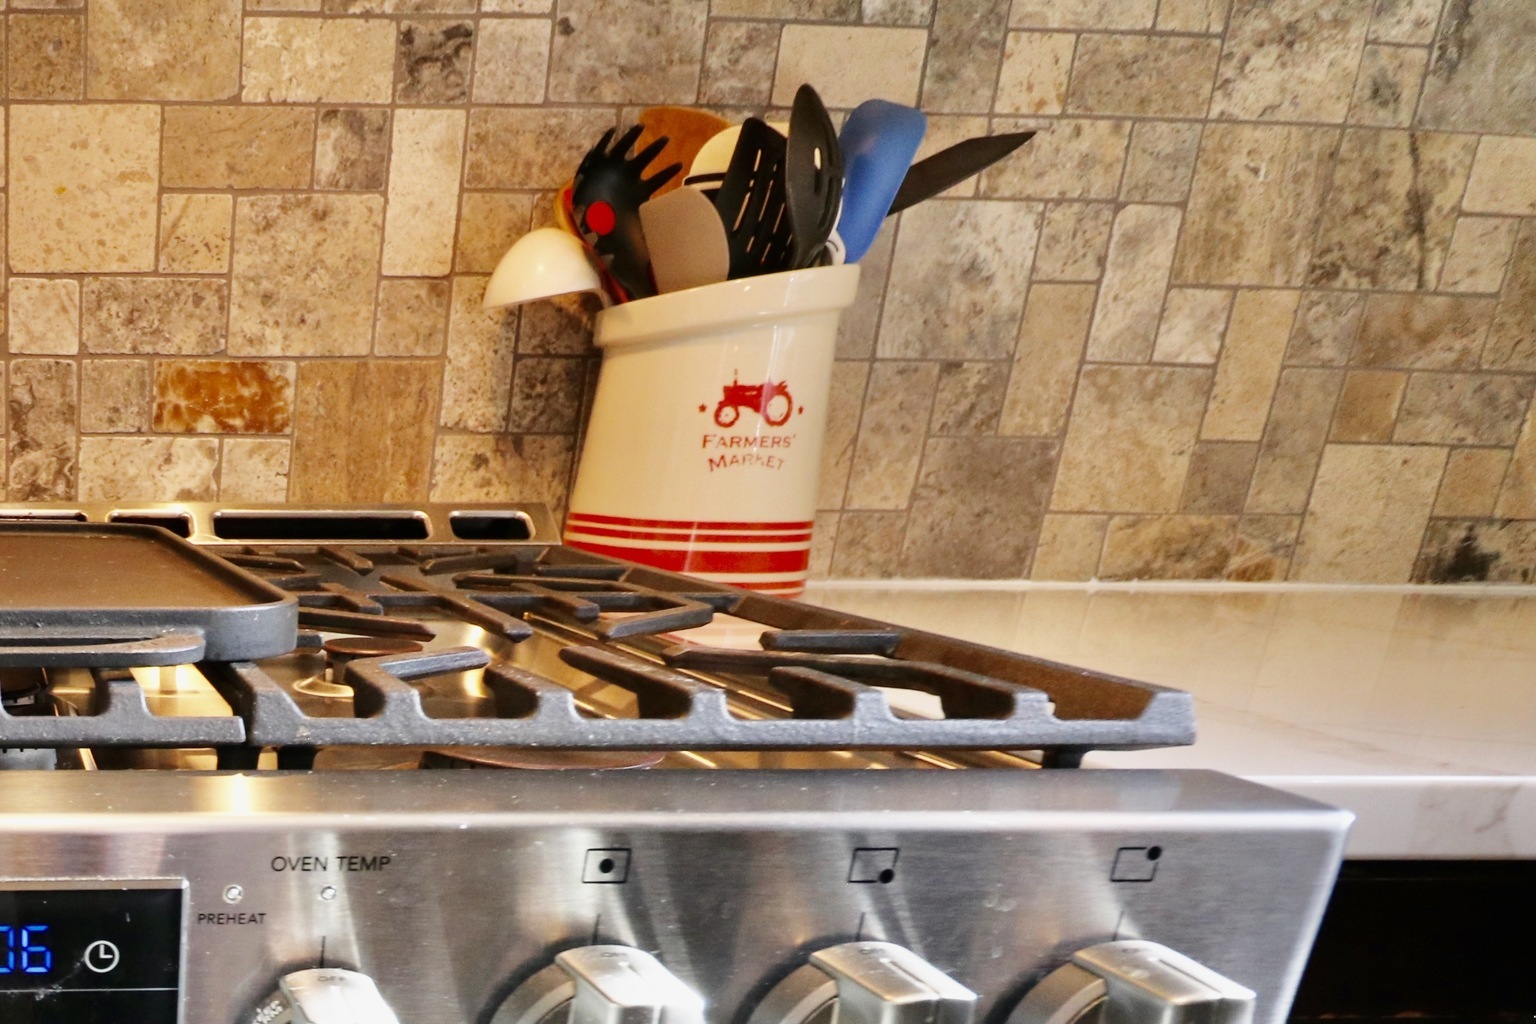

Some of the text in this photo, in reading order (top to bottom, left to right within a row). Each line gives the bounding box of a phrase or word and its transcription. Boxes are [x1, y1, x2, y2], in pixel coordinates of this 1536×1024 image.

[701, 433, 796, 449] FARMERS'
[708, 454, 785, 472] MARKET
[270, 855, 391, 872] OVEN TEMP
[197, 912, 267, 925] PREHEAT
